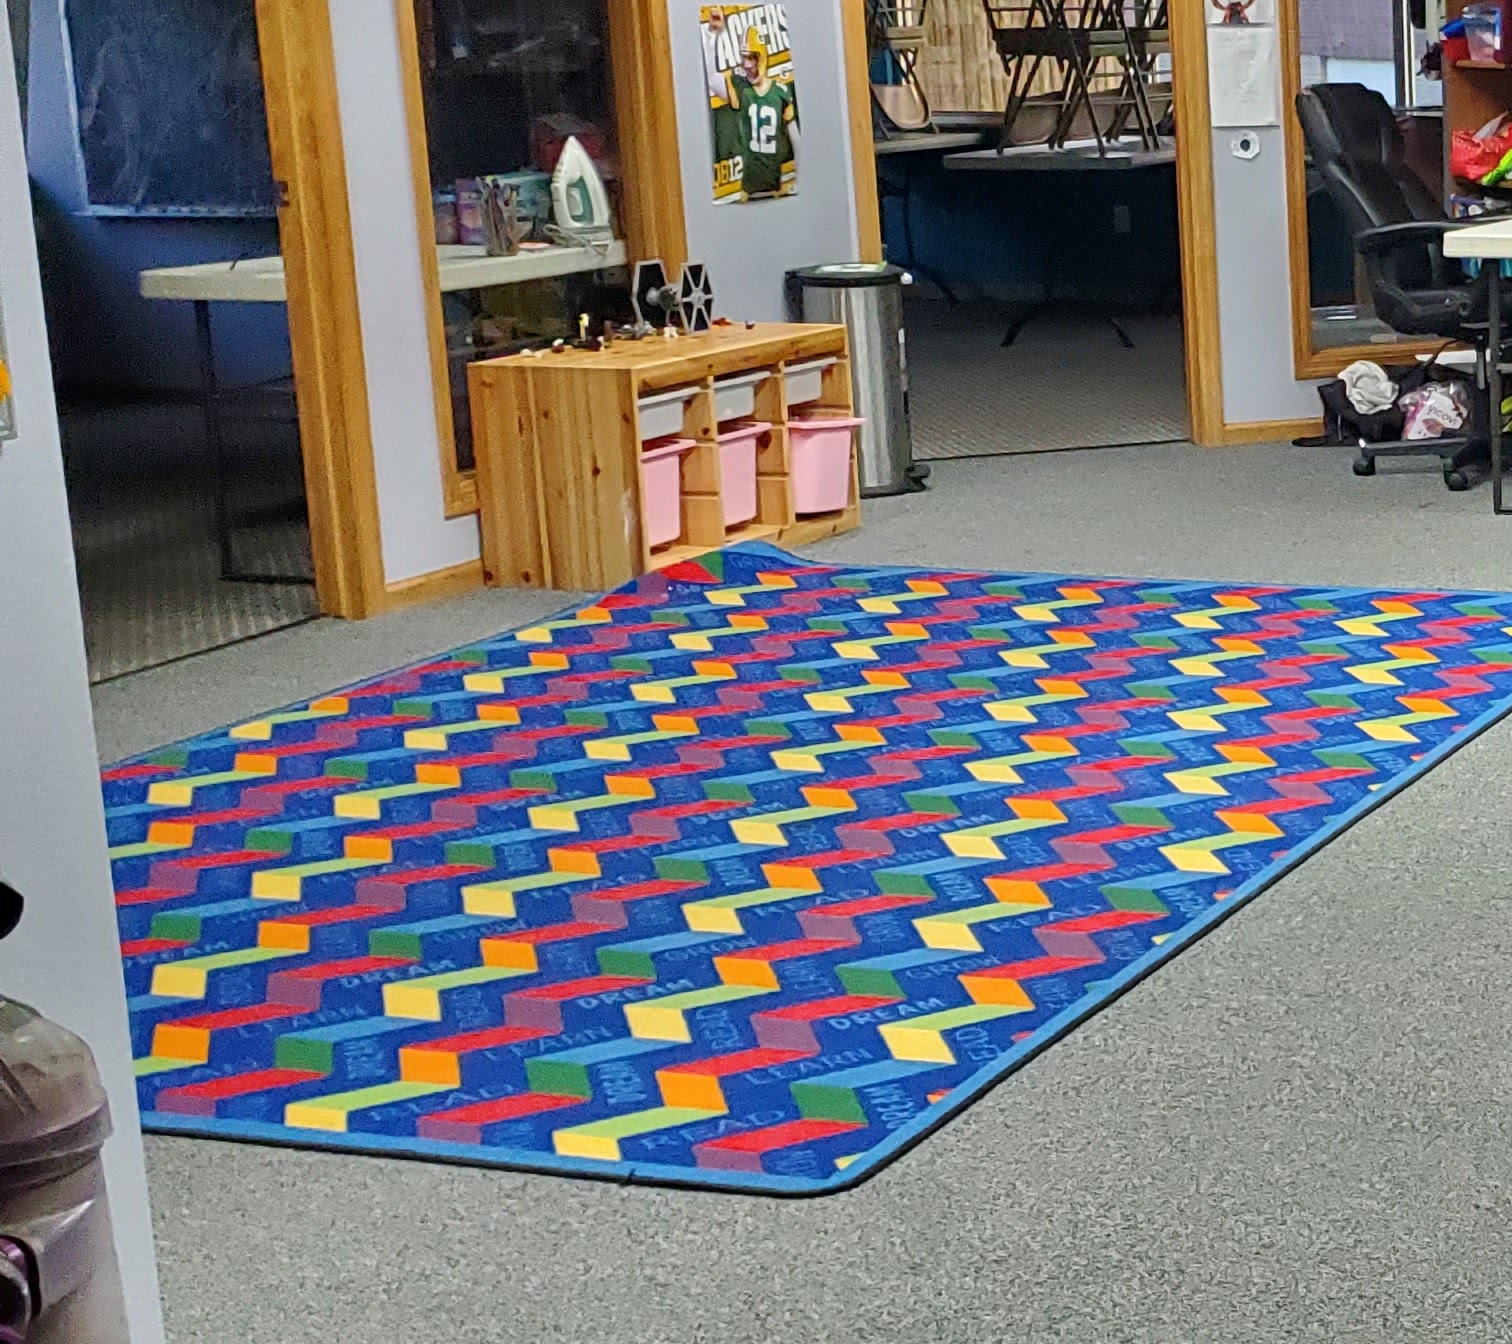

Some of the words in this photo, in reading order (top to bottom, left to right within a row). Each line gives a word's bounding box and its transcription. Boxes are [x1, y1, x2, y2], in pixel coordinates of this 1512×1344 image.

[748, 103, 777, 154] 12
[899, 813, 996, 837] DREAM
[1115, 824, 1214, 851] DREAM
[576, 978, 696, 1010] DREAM
[828, 997, 946, 1030] DREAM
[743, 1047, 875, 1087] LEARN
[639, 1110, 786, 1152] READ
